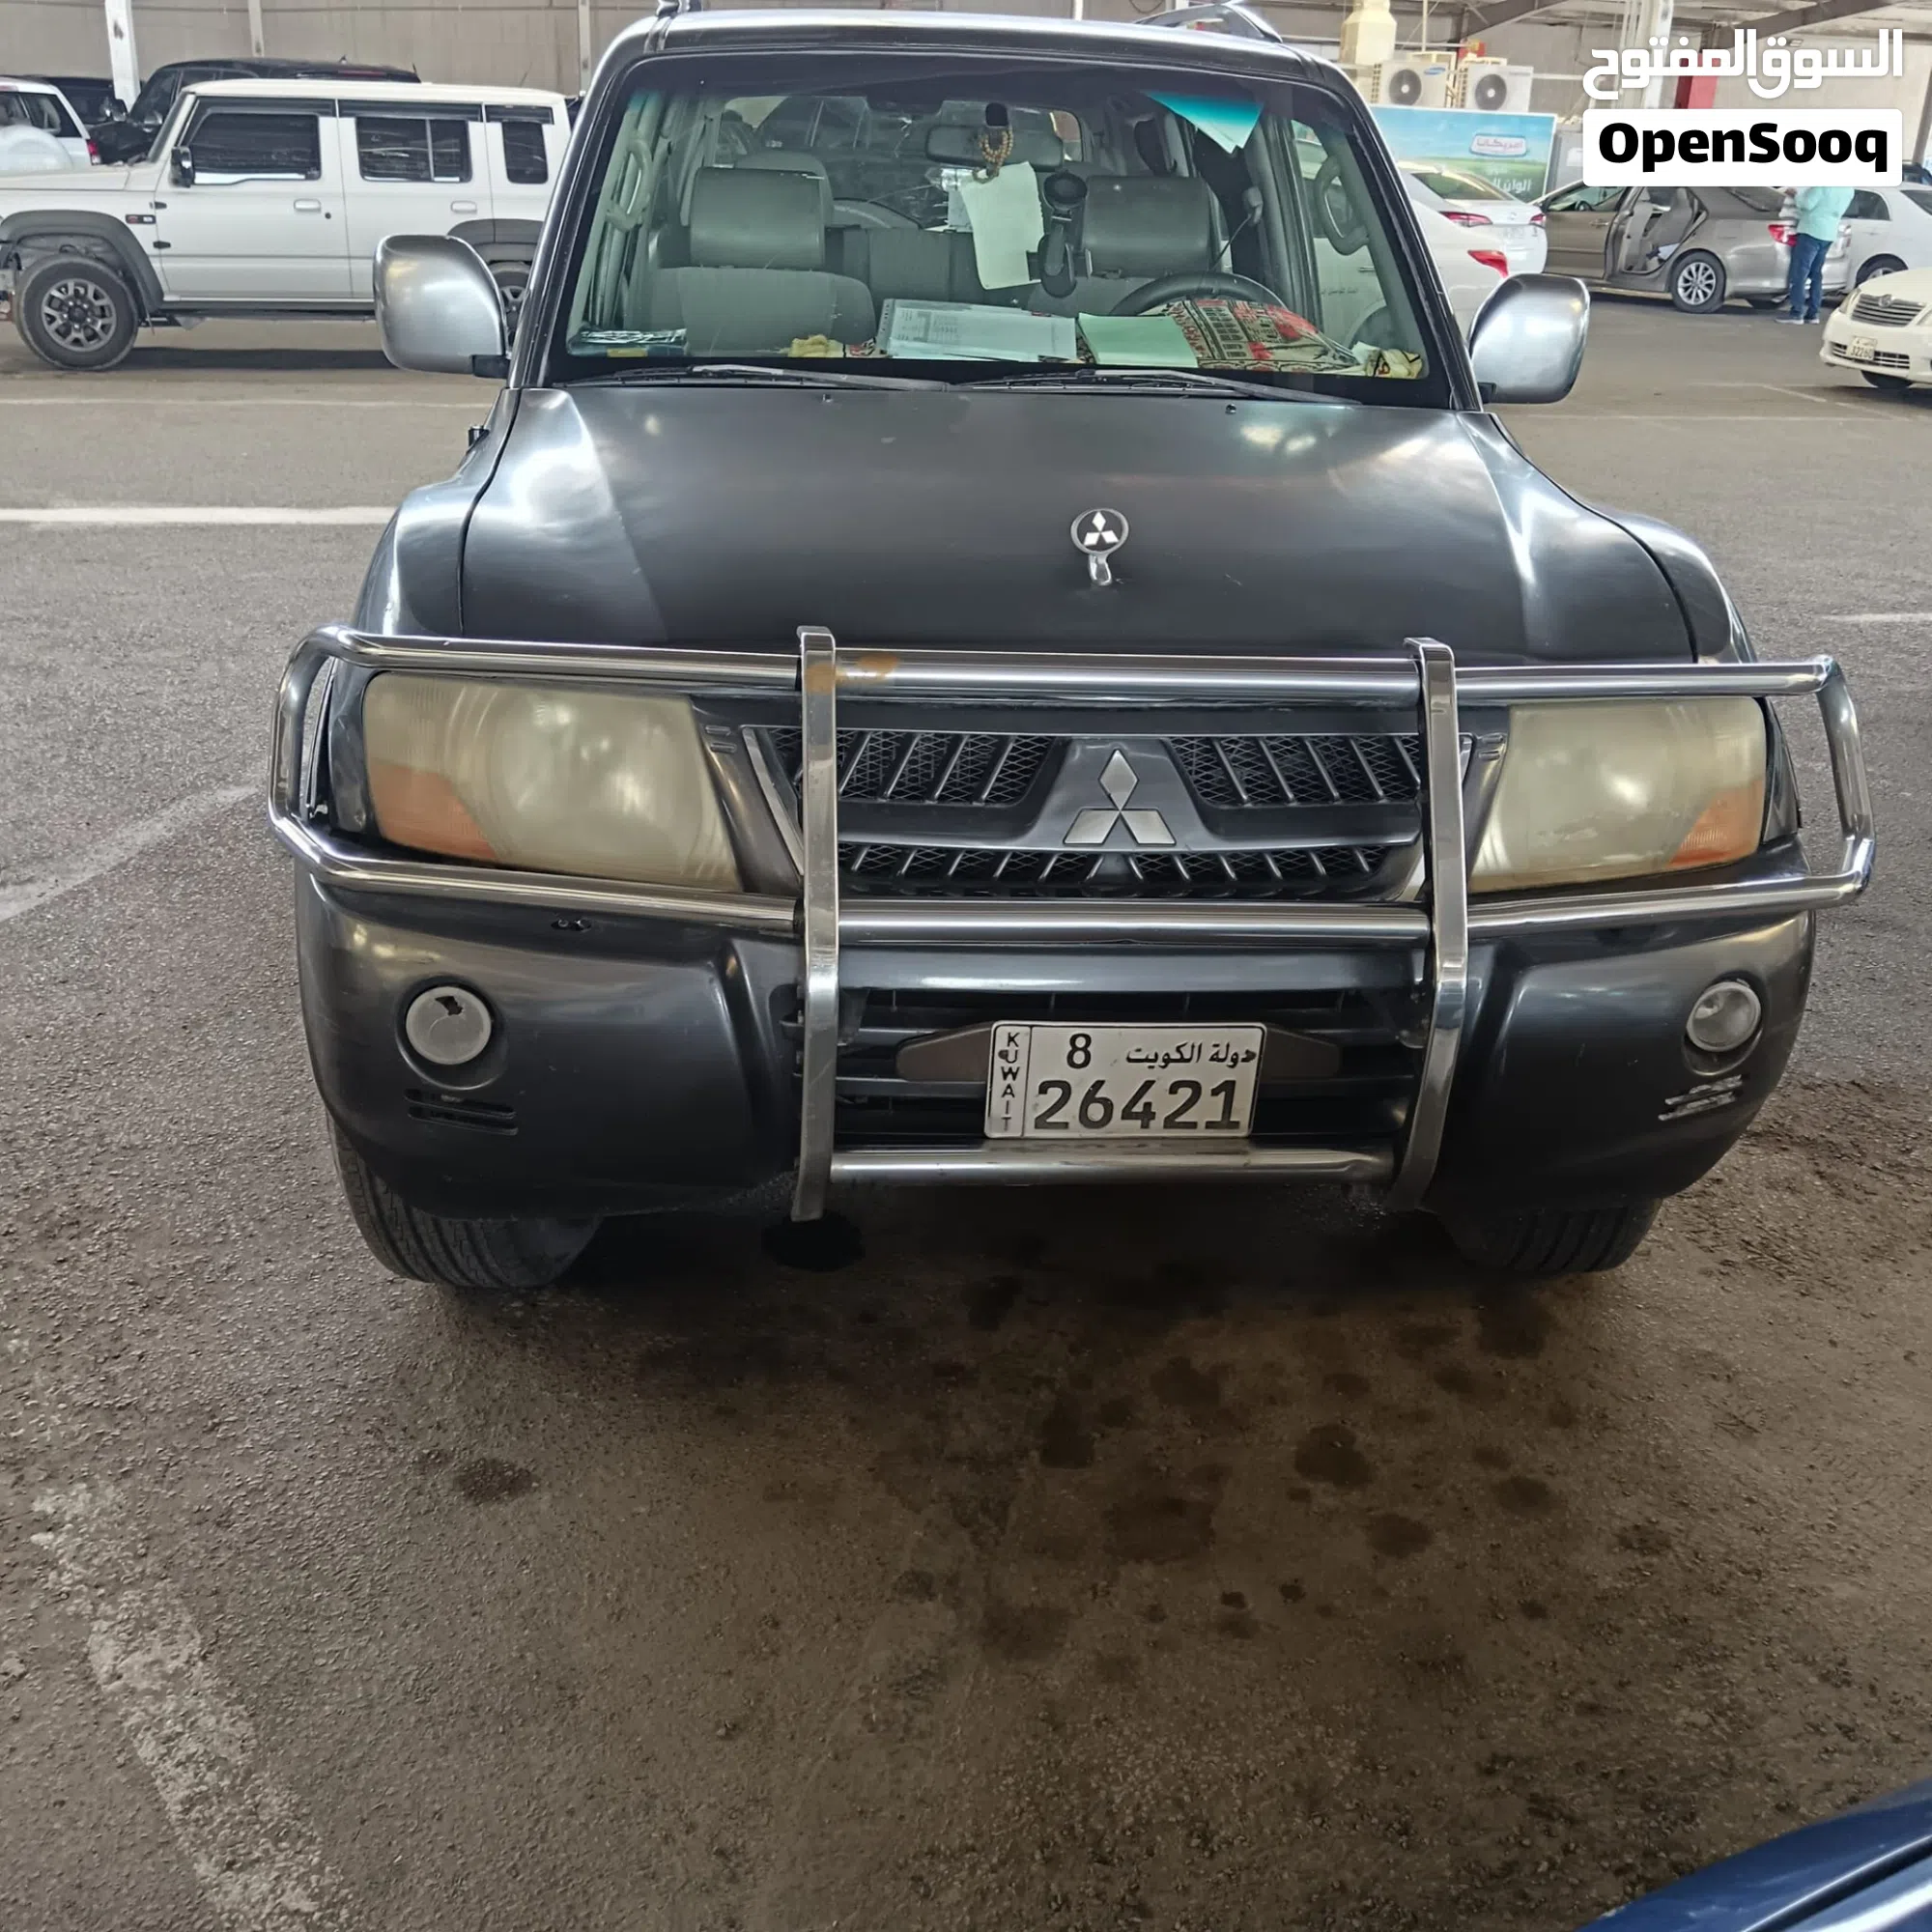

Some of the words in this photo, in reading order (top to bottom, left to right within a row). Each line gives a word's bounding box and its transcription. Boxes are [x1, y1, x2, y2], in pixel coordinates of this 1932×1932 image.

[1065, 1033, 1093, 1069] 8
[1125, 1041, 1203, 1069] الكويت
[1208, 1041, 1256, 1068] دولة
[1001, 1032, 1021, 1132] KUWAIT
[1034, 1079, 1241, 1131] 26421
